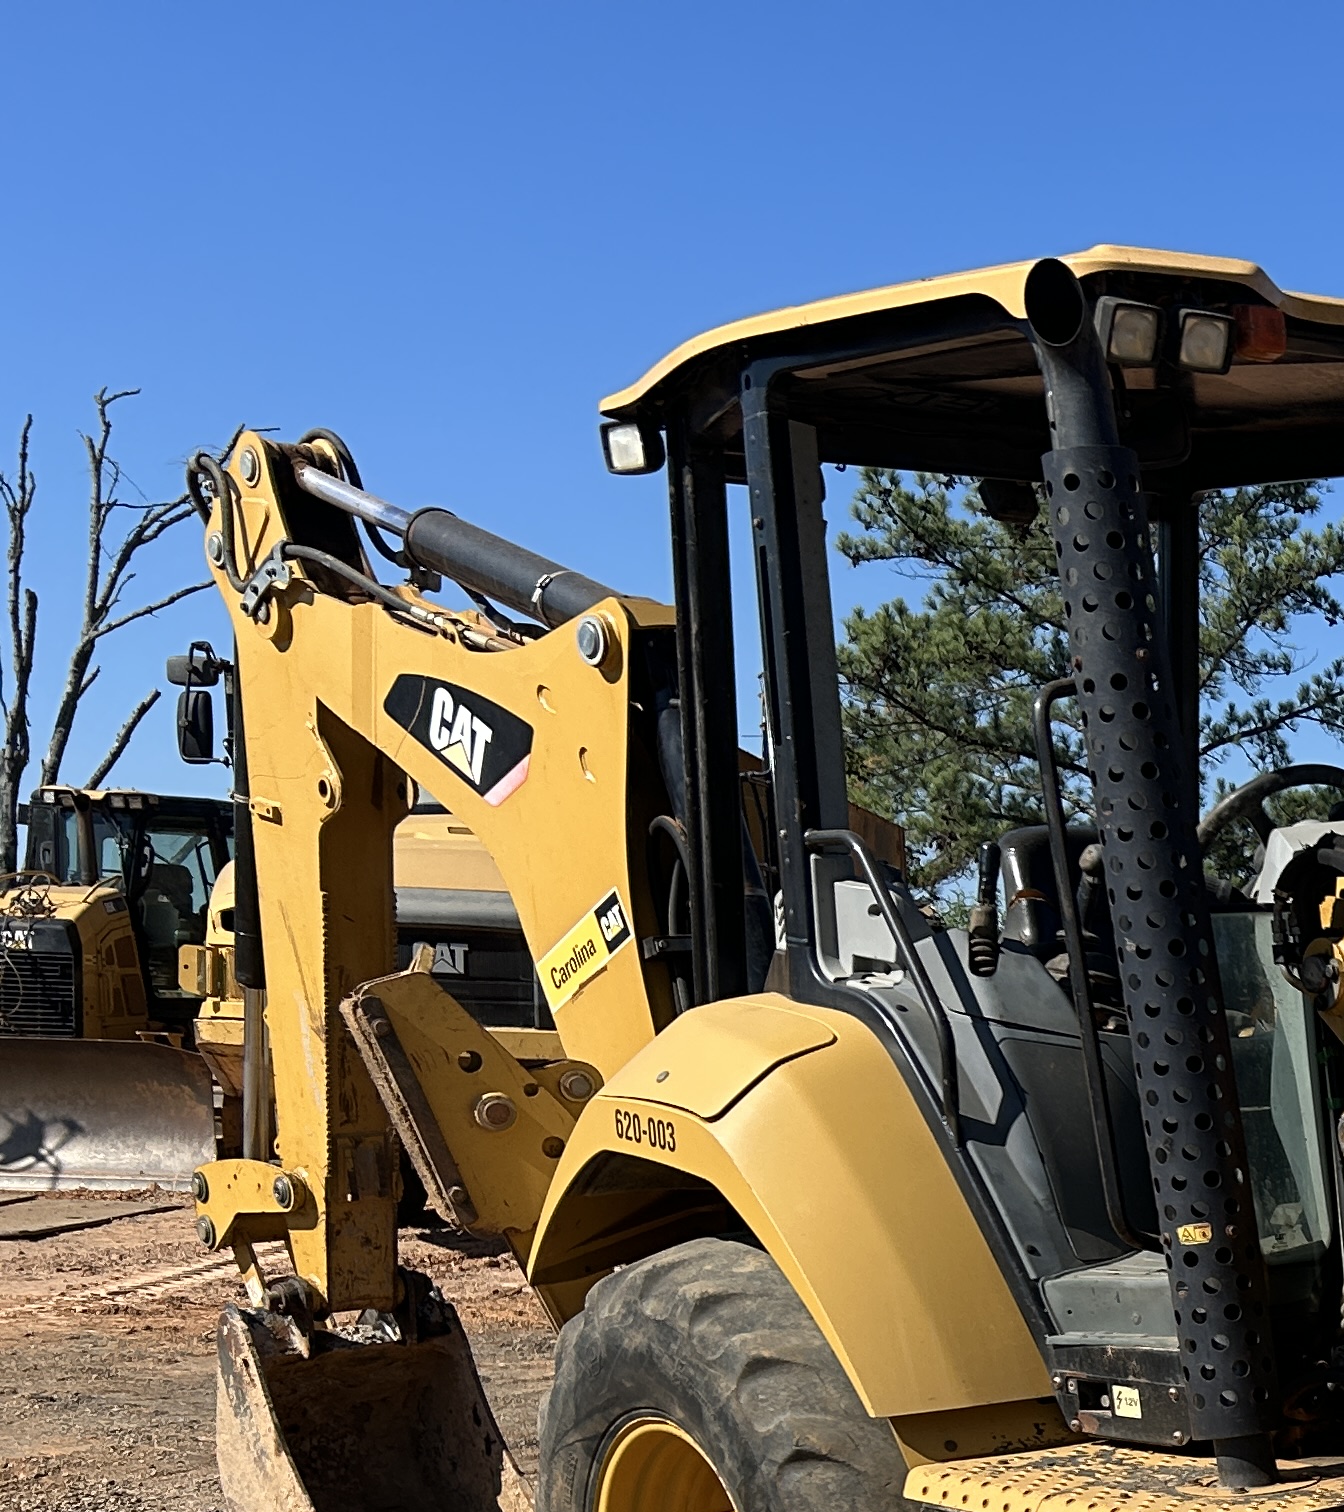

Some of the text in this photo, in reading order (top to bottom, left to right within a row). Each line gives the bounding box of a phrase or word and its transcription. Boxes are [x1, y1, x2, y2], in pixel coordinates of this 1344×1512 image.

[429, 686, 493, 786] CAT
[550, 902, 625, 990] Carolina CAT
[614, 1108, 677, 1153] 620-003
